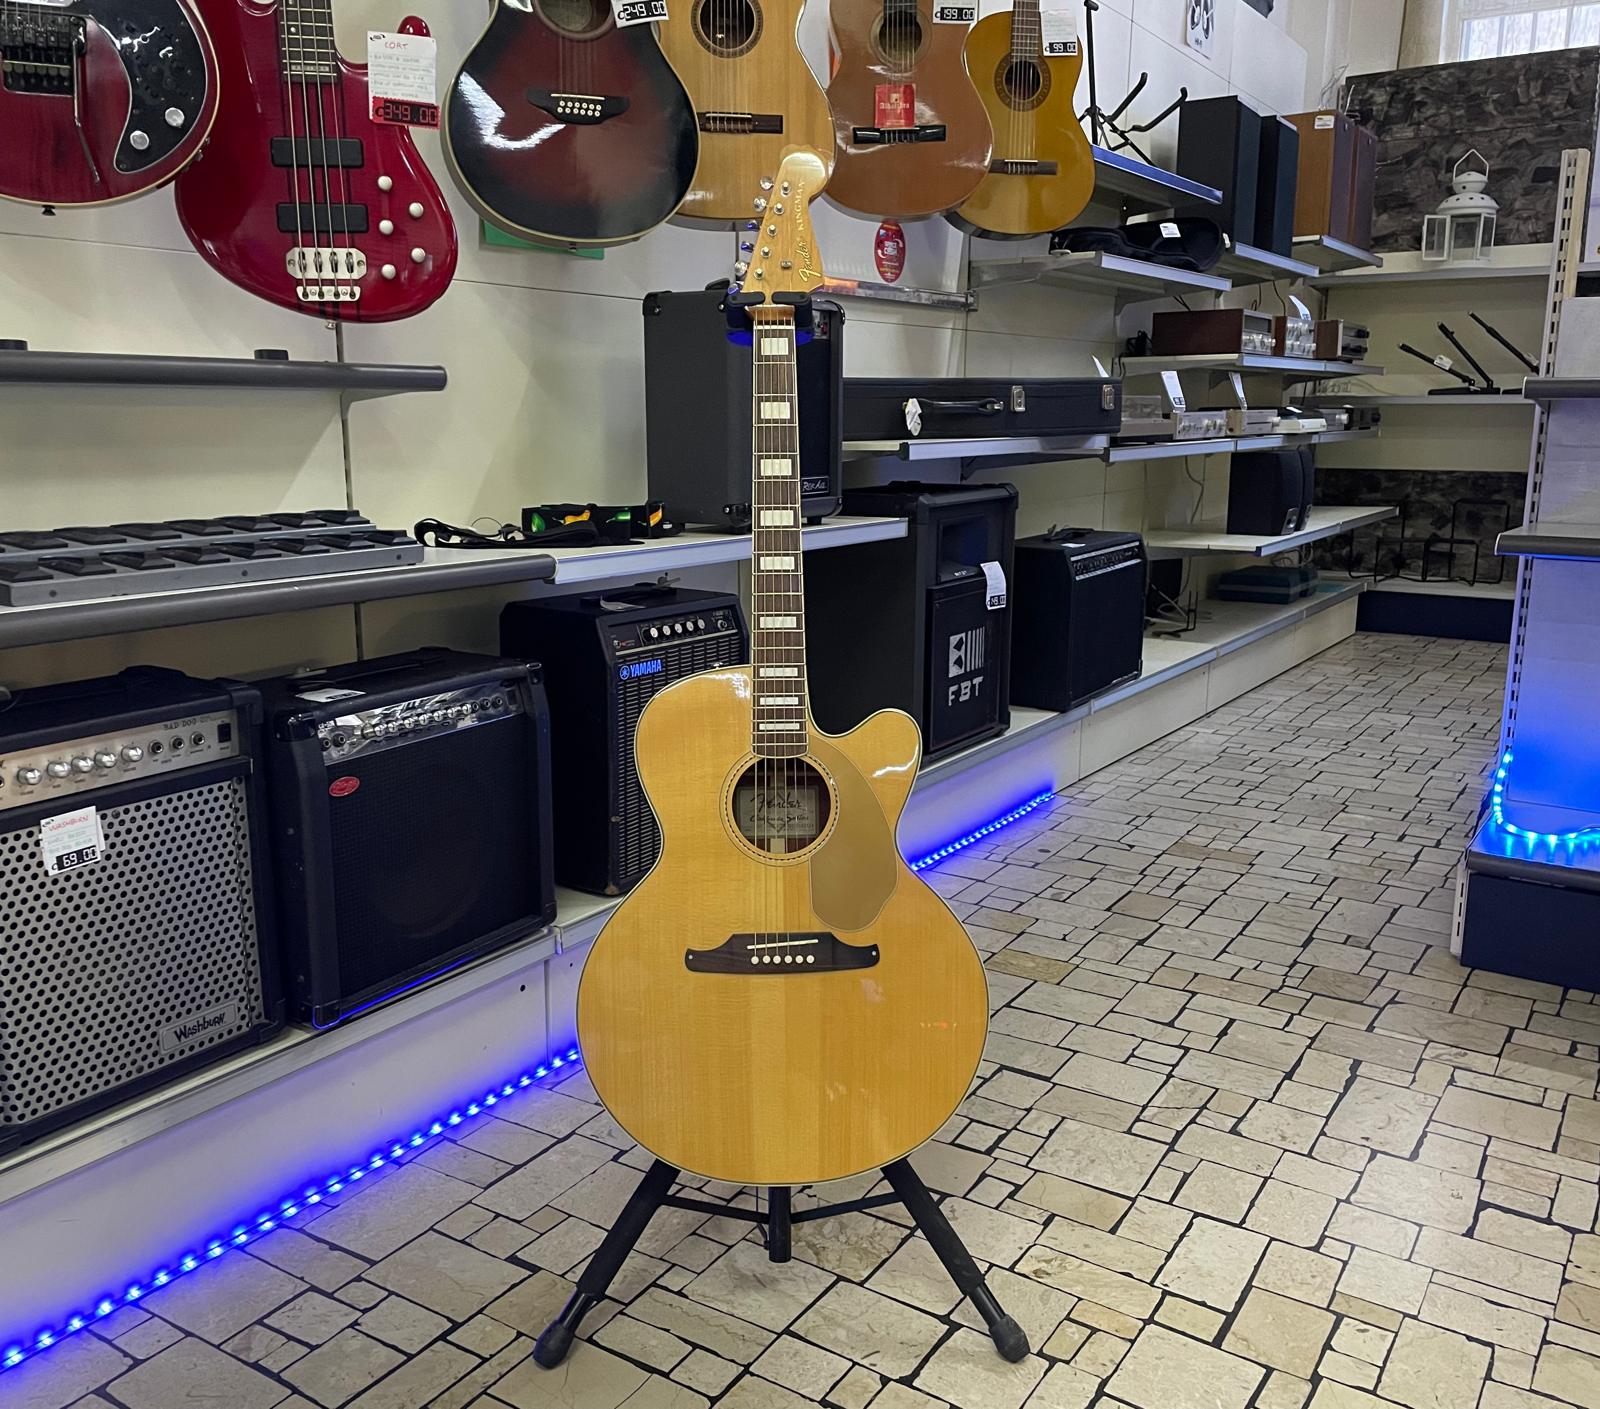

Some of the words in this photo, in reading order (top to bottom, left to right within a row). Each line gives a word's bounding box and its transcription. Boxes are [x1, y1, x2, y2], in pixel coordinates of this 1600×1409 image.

[795, 240, 821, 282] Fender
[630, 659, 662, 678] YAMAHA
[948, 676, 984, 707] FBT
